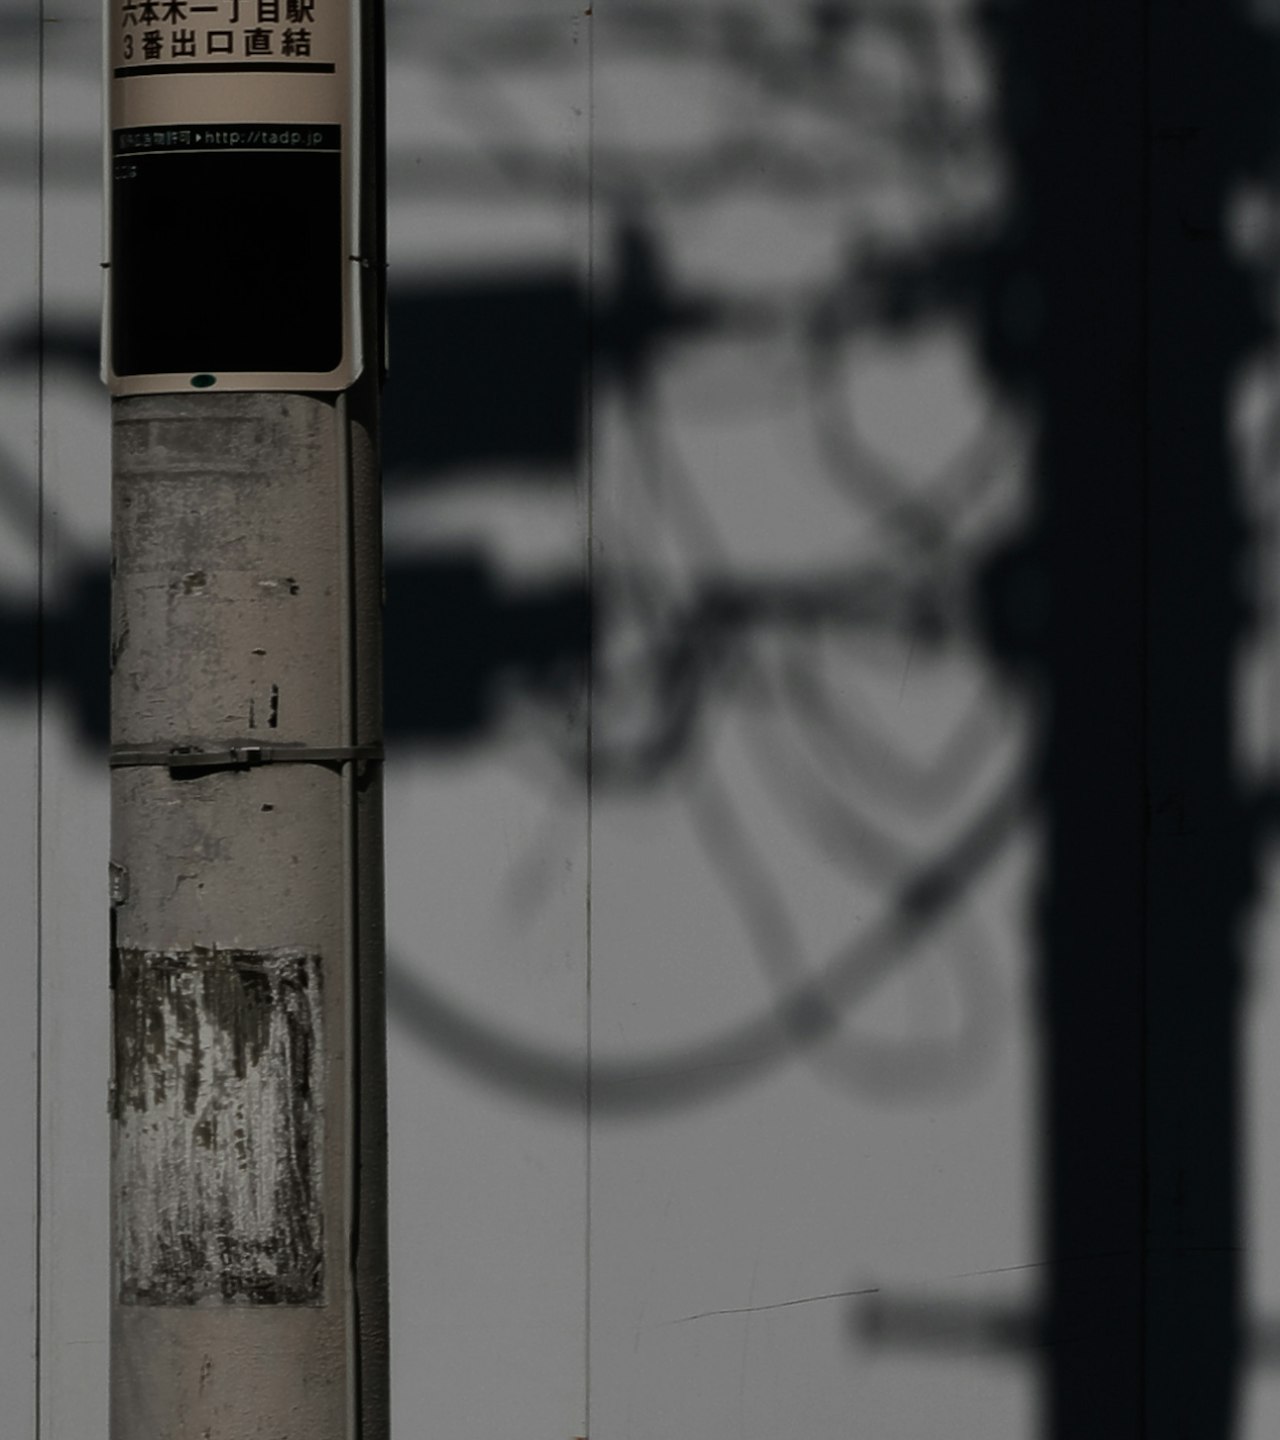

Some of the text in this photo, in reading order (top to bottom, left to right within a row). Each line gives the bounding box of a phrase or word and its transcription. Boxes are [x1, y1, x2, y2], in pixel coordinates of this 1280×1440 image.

[122, 28, 312, 60] 3番出口直結
